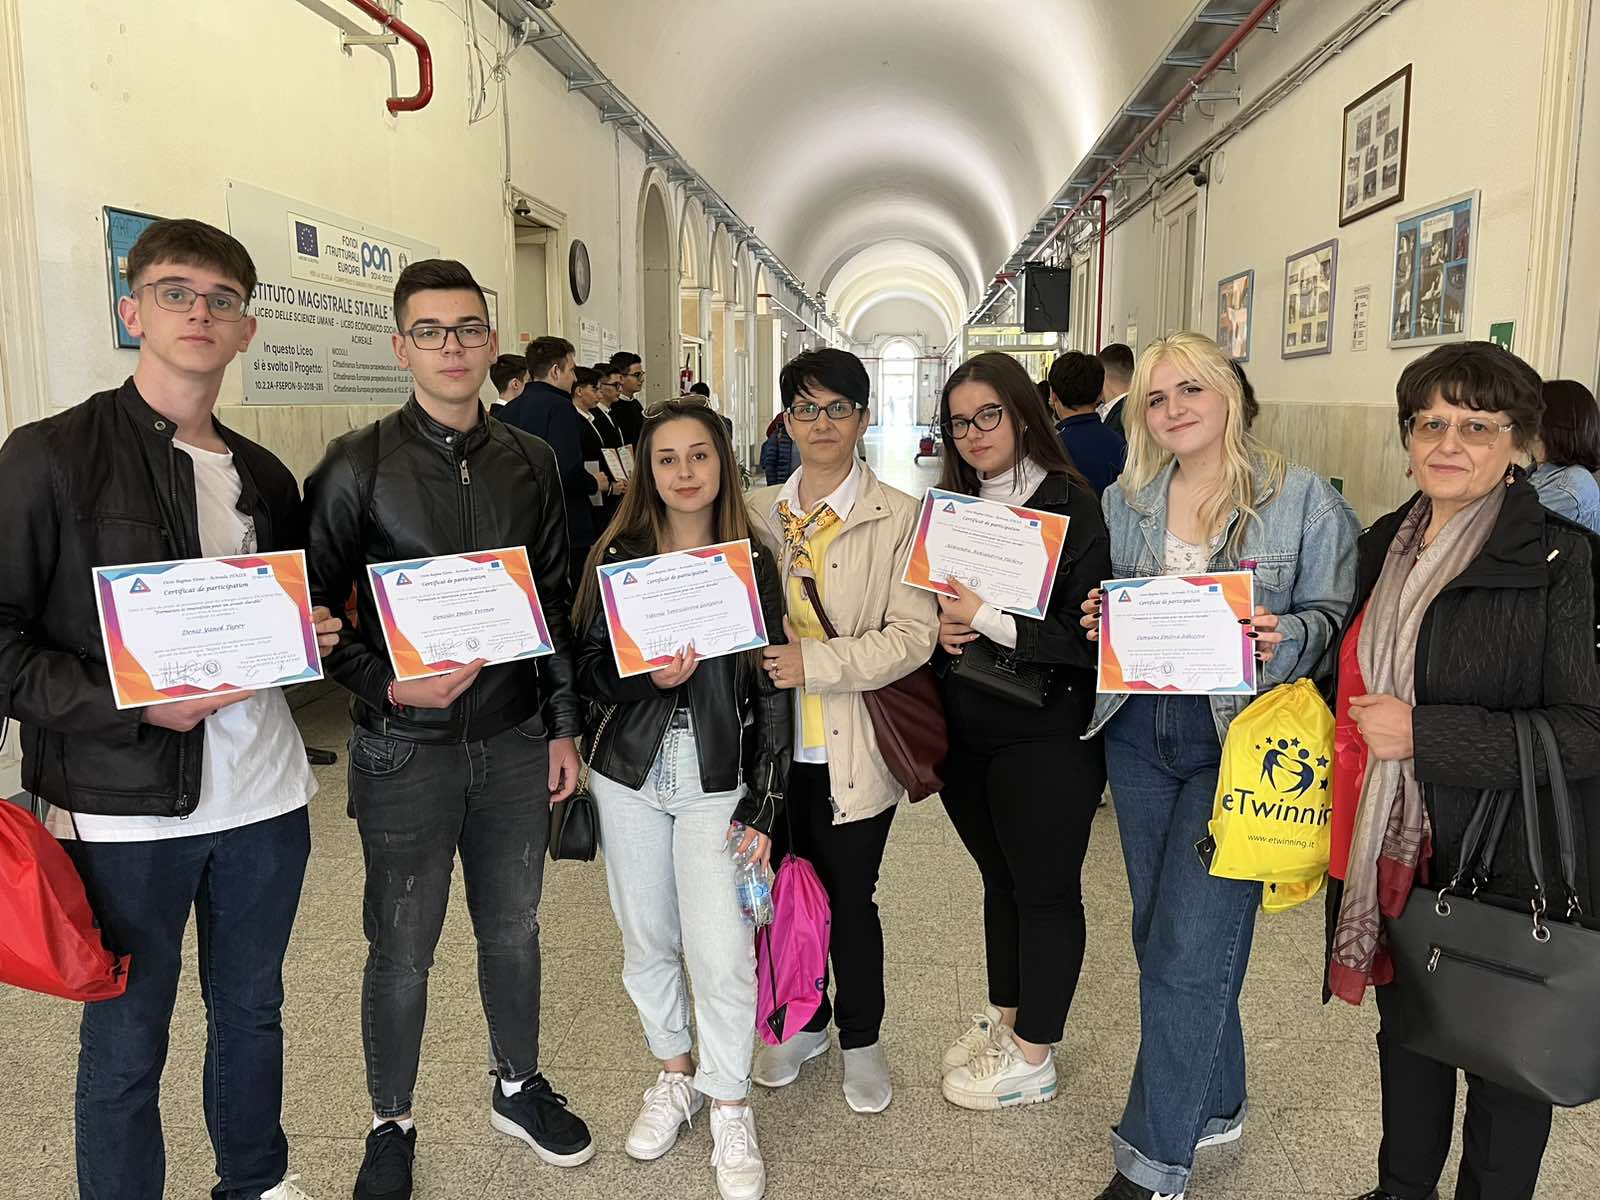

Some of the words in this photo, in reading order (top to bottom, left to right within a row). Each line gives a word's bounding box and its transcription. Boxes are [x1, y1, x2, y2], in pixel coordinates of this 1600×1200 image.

[361, 241, 392, 277] pon
[337, 262, 361, 276] EUROPEI
[252, 281, 295, 305] STITUTO
[298, 289, 353, 315] MAGISTRALE
[354, 300, 388, 320] STATALE
[254, 307, 274, 319] LICEO
[275, 309, 293, 321] DELLE
[293, 312, 316, 325] SCIENZE
[317, 316, 335, 327] UMANE
[340, 320, 354, 330] LICEO
[354, 322, 383, 334] ECONOMICO
[351, 335, 373, 345] ACIREALE
[263, 341, 271, 353] In
[272, 344, 295, 356] questo
[296, 344, 313, 356] Liceo
[267, 360, 288, 372] svolto
[295, 361, 323, 376] Progetto:
[163, 587, 196, 597] Certificat
[206, 581, 249, 593] participation
[1247, 834, 1315, 849] www.etwinning.it
